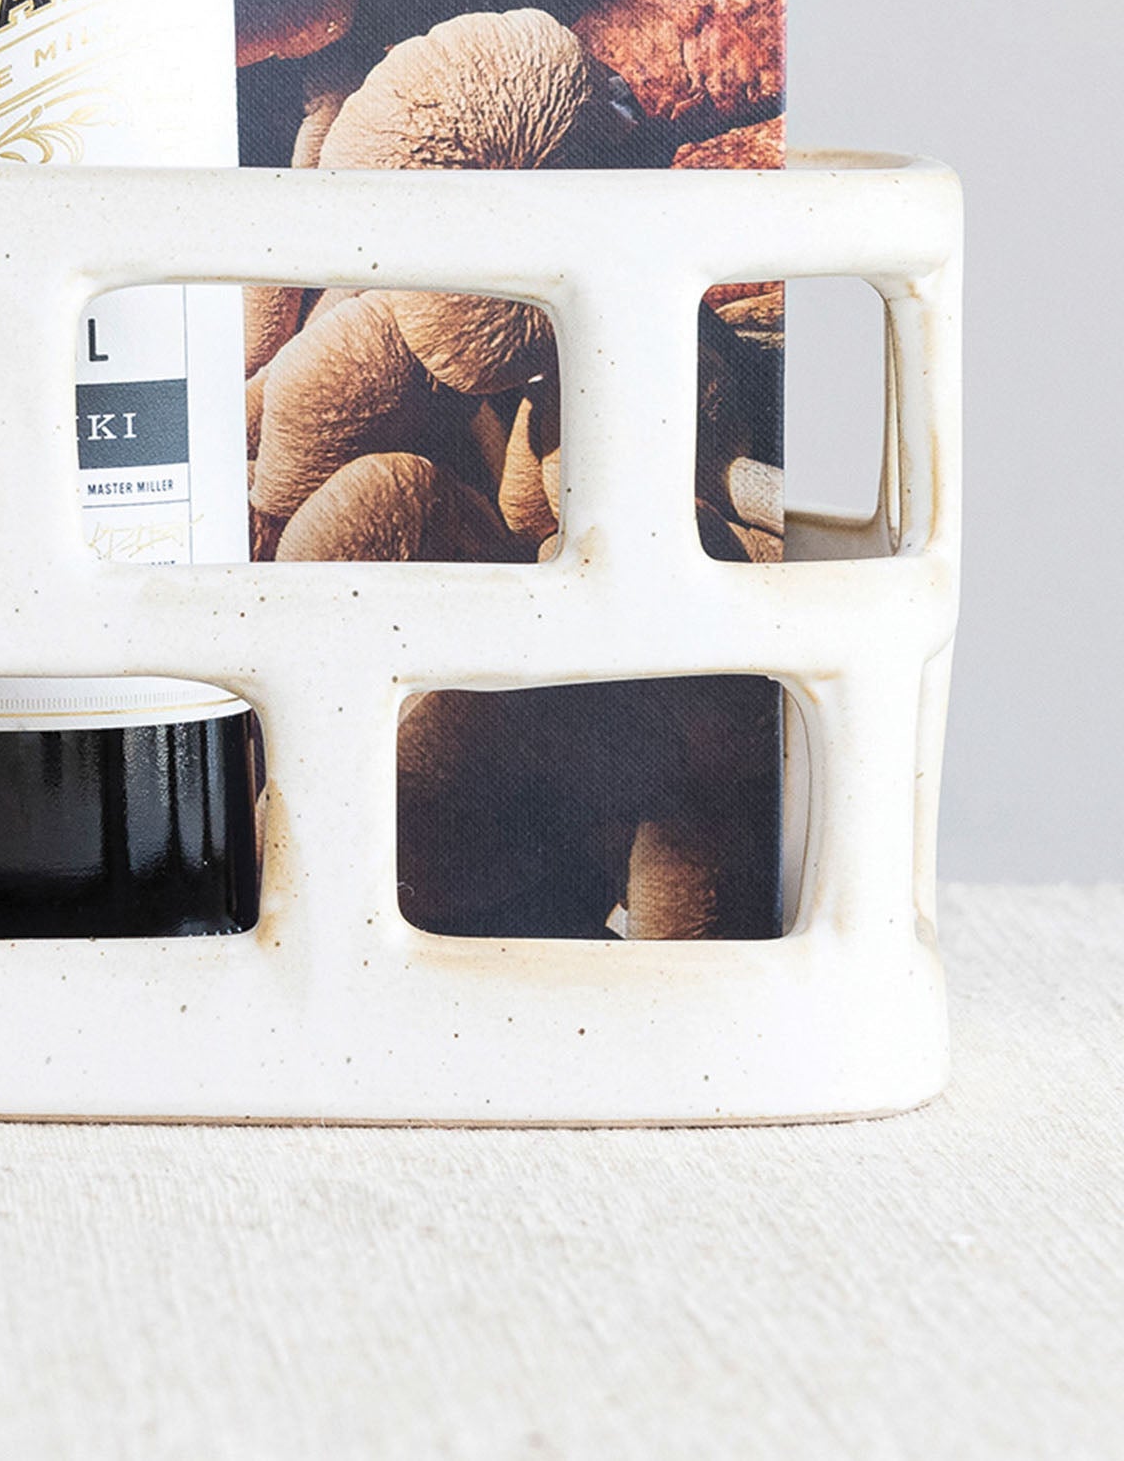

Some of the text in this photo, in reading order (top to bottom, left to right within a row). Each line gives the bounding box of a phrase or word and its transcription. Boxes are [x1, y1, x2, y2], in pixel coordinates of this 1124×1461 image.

[78, 413, 138, 441] KI
[87, 478, 173, 496] MASTER MILLER
